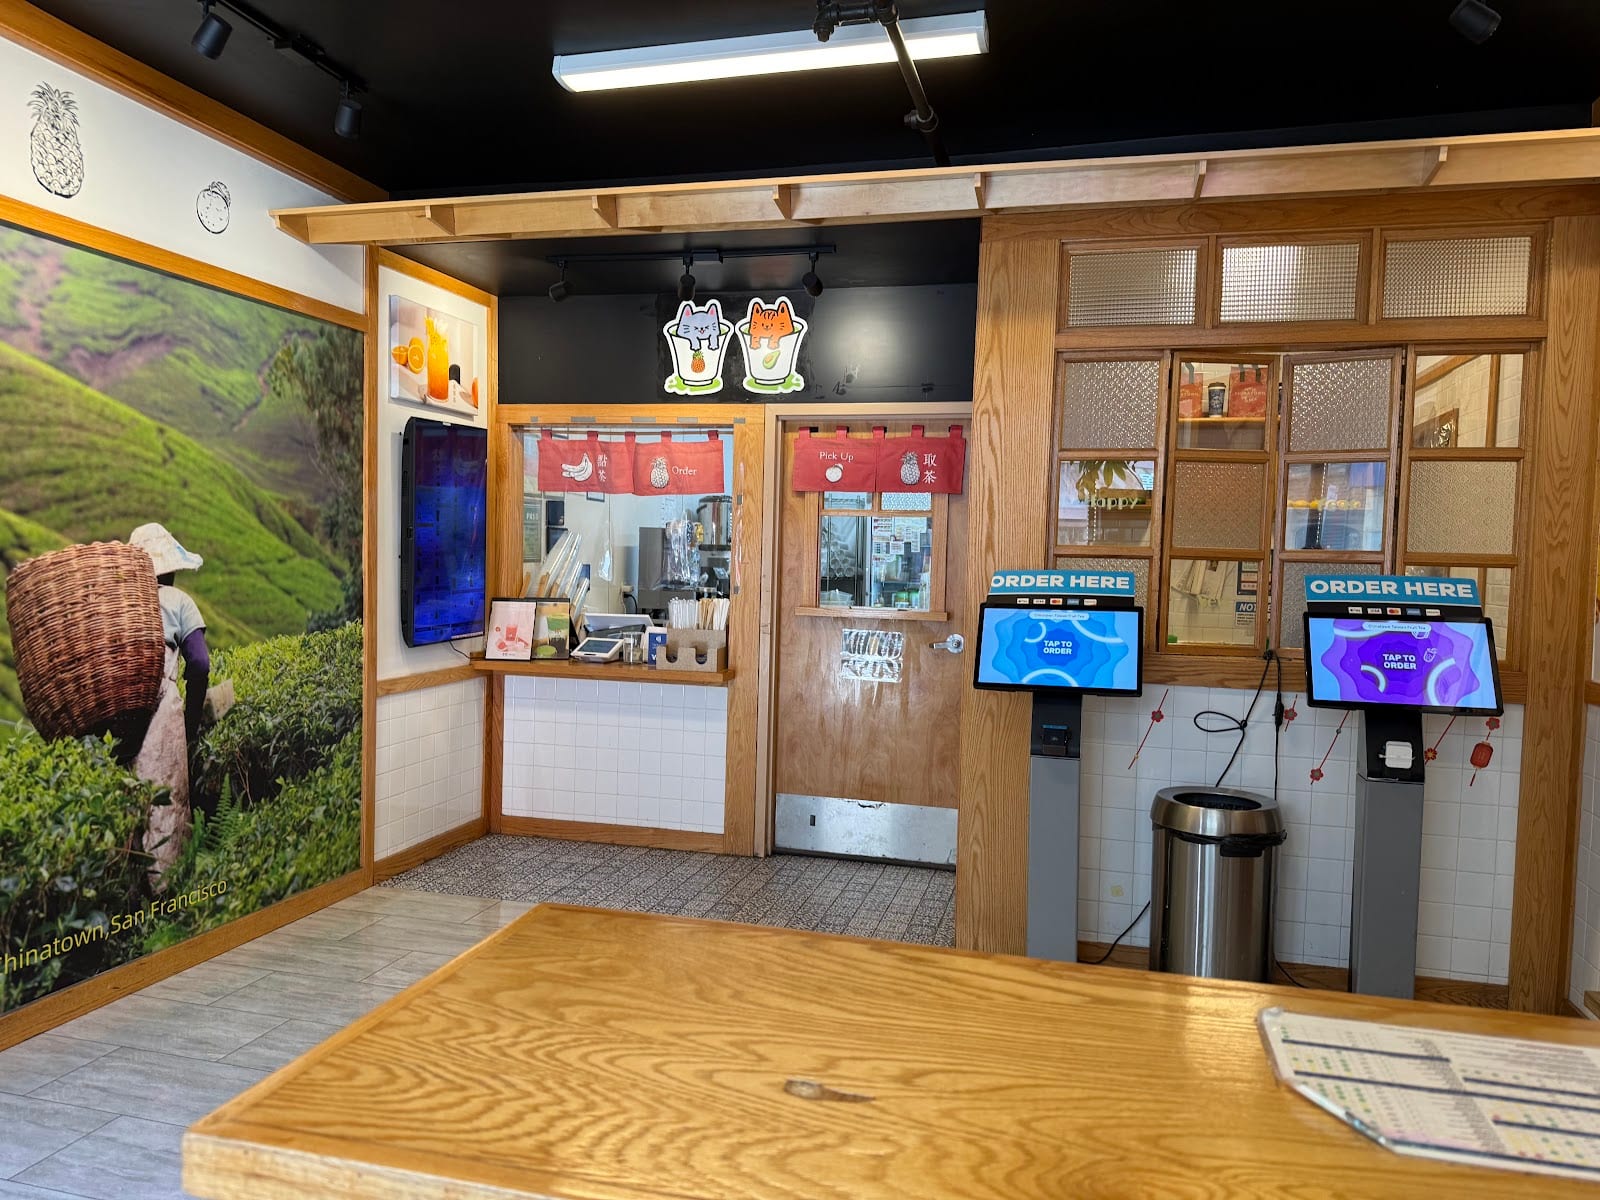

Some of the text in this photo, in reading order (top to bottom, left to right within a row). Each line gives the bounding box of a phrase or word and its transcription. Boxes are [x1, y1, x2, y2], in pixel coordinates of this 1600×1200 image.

[819, 451, 854, 463] Pick Up
[672, 466, 697, 476] Order
[923, 453, 937, 484] 取茶
[991, 575, 1130, 589] ORDER HERE
[1310, 580, 1474, 598] ORDER HERE
[1382, 653, 1401, 661] TAP
[1383, 662, 1417, 670] ORDER
[151, 880, 227, 919] Francisco
